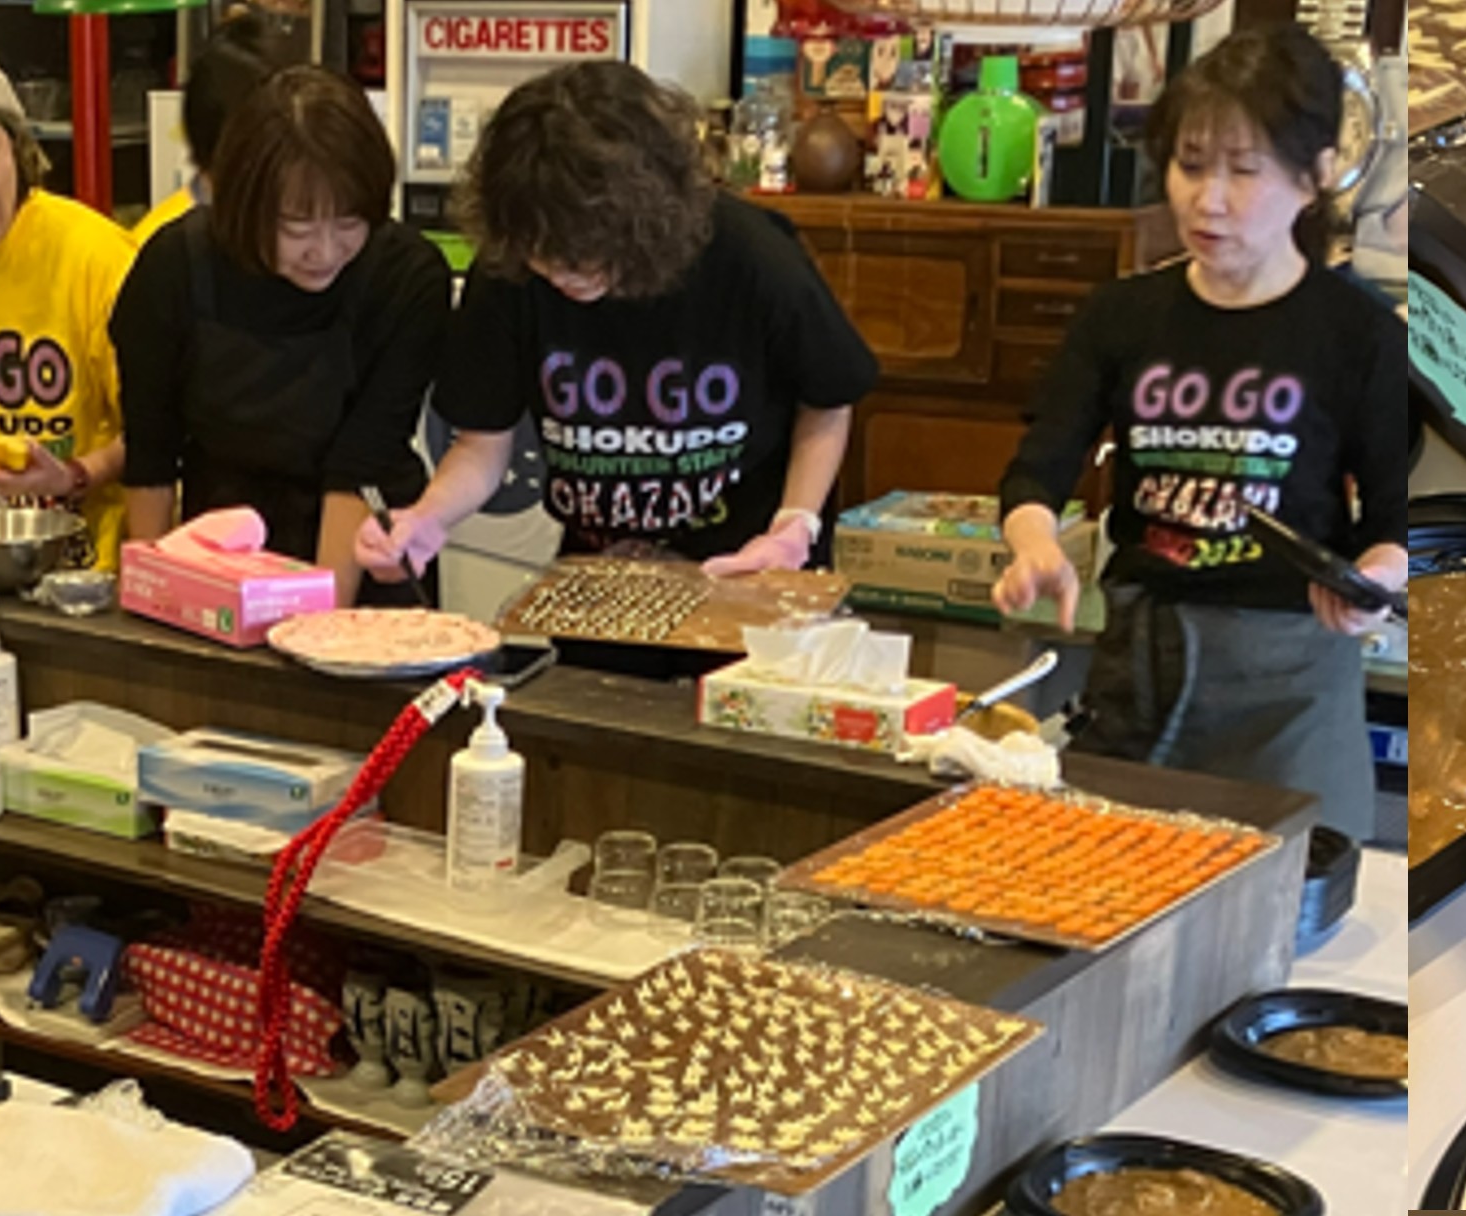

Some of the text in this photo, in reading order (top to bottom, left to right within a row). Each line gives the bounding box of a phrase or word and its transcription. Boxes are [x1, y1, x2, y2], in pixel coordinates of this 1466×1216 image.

[425, 16, 609, 52] CIGARETTES
[541, 351, 740, 424] GO GO
[1133, 364, 1304, 424] GO GO
[541, 416, 748, 454] SHOKUDO
[1130, 425, 1298, 457] SHOKUDO
[551, 468, 740, 530] OKAZAK
